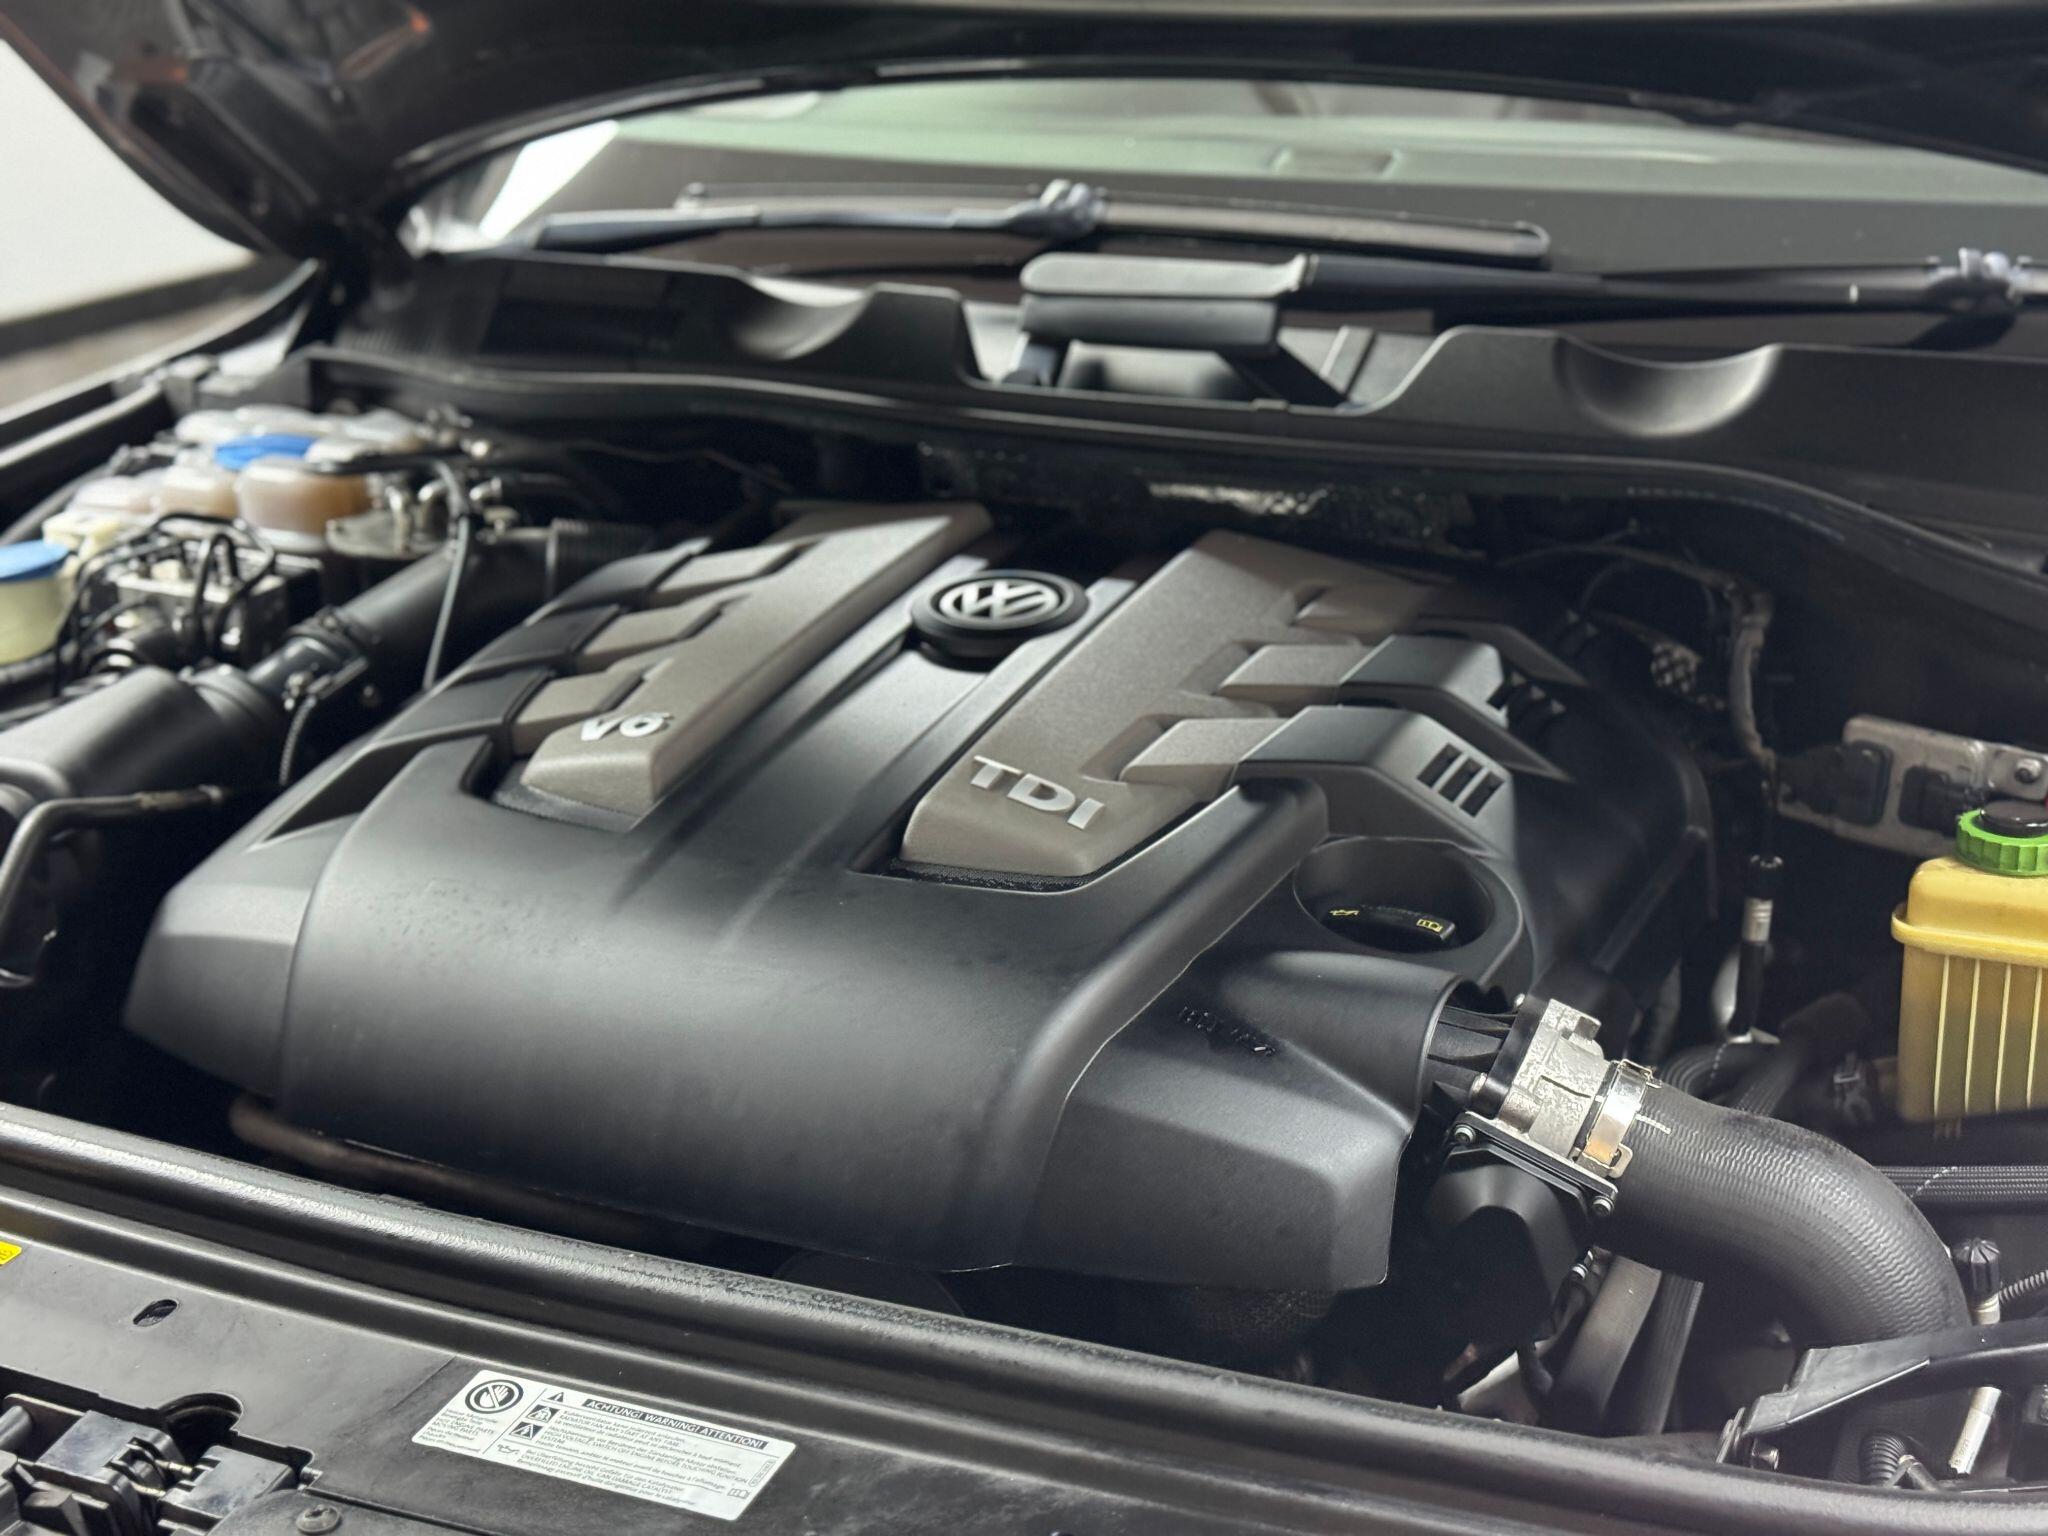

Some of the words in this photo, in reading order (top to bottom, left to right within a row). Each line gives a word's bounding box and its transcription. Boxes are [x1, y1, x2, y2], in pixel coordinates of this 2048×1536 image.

[581, 712, 672, 741] V6
[970, 755, 1105, 829] TDI
[586, 1400, 642, 1420] ACHTUNG!
[644, 1413, 699, 1433] WARNING!
[700, 1426, 764, 1449] ATTENTION!
